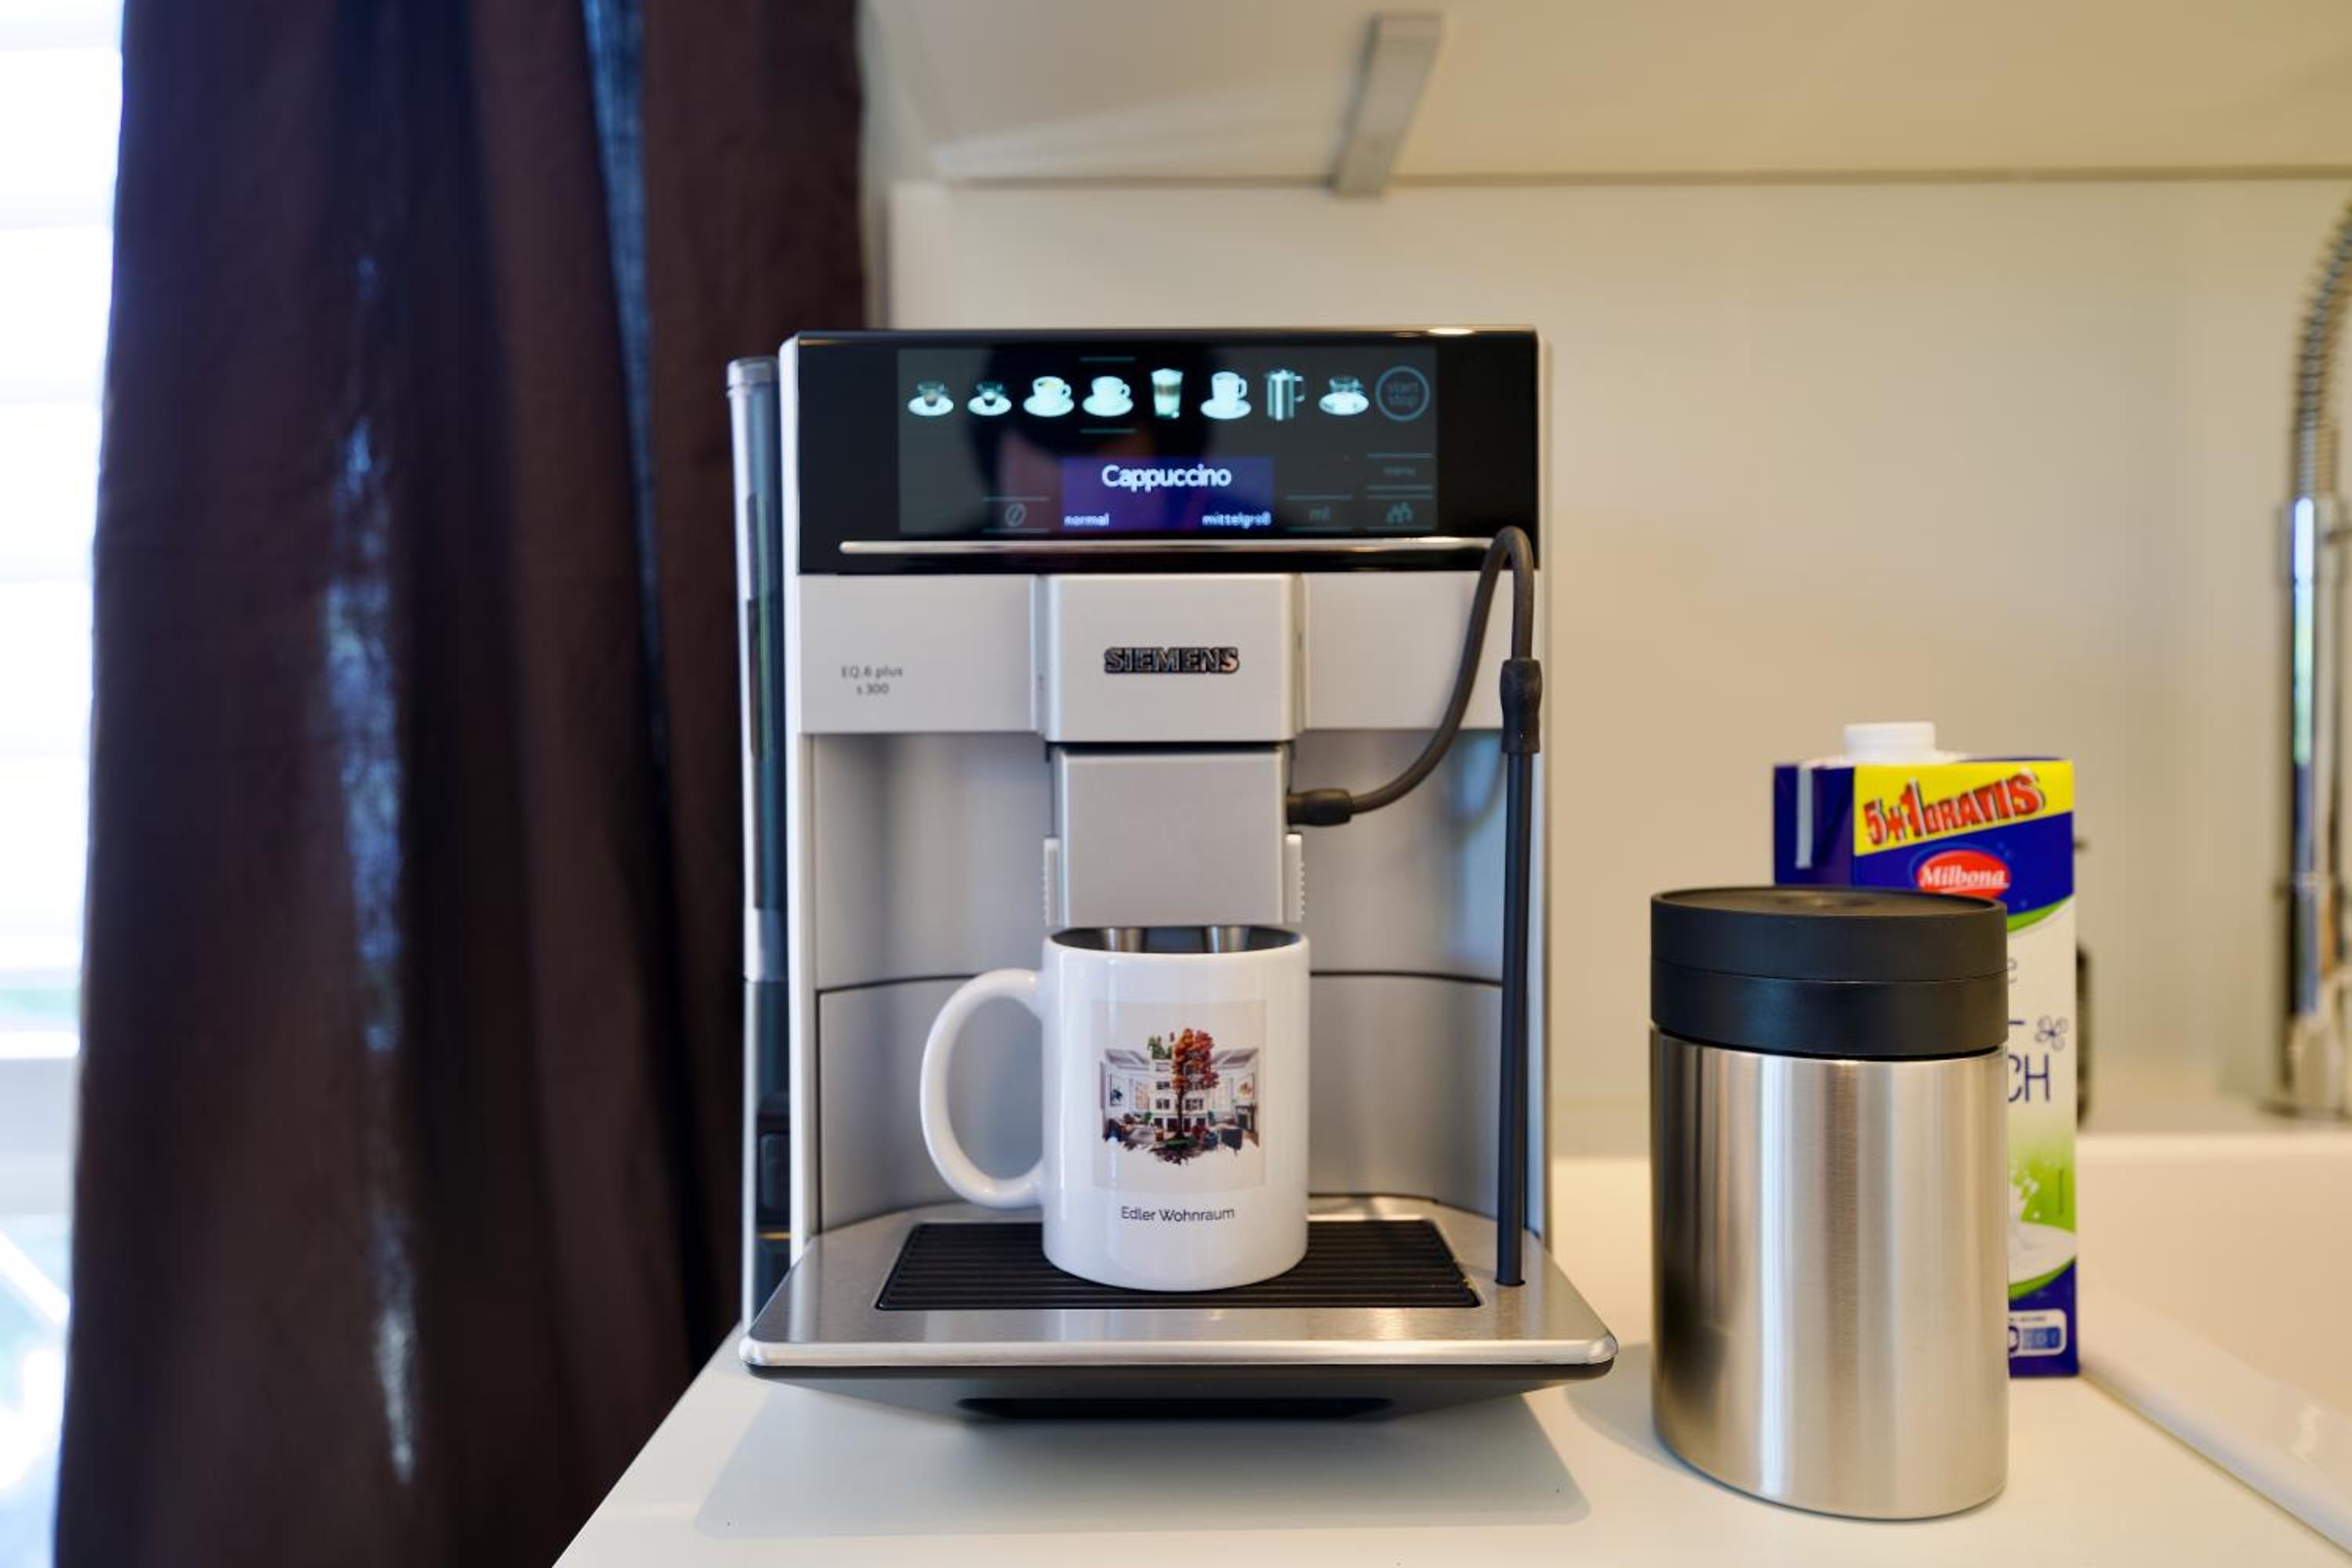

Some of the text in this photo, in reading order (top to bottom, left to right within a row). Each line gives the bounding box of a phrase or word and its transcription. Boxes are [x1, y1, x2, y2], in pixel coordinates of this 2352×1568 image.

[1102, 463, 1232, 492] Cappuccino
[1064, 511, 1109, 527] normal
[1202, 510, 1272, 529] mittelgroß
[1104, 648, 1240, 674] SIEMENS
[875, 664, 903, 680] plus
[1919, 864, 2007, 888] Milbona
[1120, 1205, 1236, 1223] Edler Wohnraum
